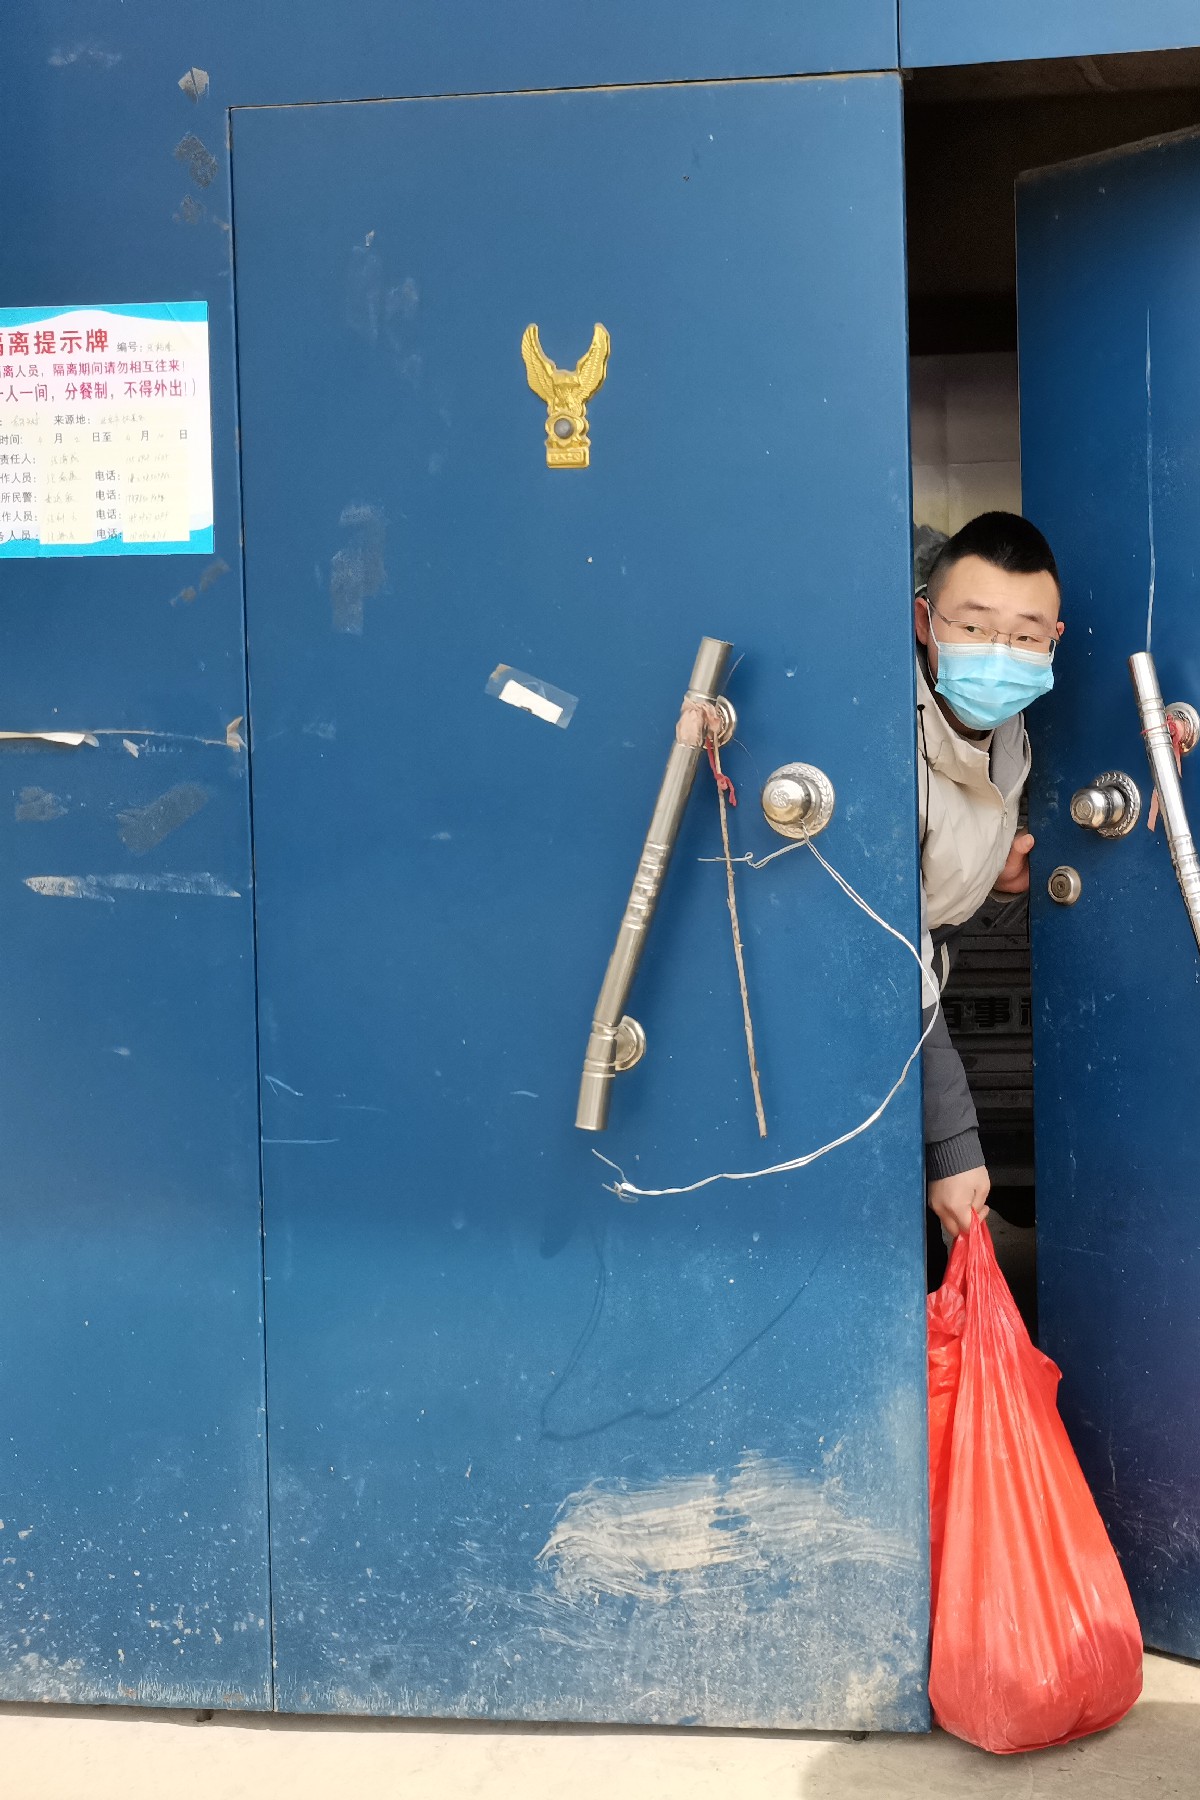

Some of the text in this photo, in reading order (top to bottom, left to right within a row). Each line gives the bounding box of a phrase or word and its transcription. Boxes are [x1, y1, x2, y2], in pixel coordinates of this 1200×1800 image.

[0, 328, 109, 356] 离提示牌
[0, 359, 186, 378] 离人员，隔离期间请勿相互往来！
[0, 378, 196, 402] 人一间，分餐制，不得外出！）
[0, 509, 38, 523] 作人员：
